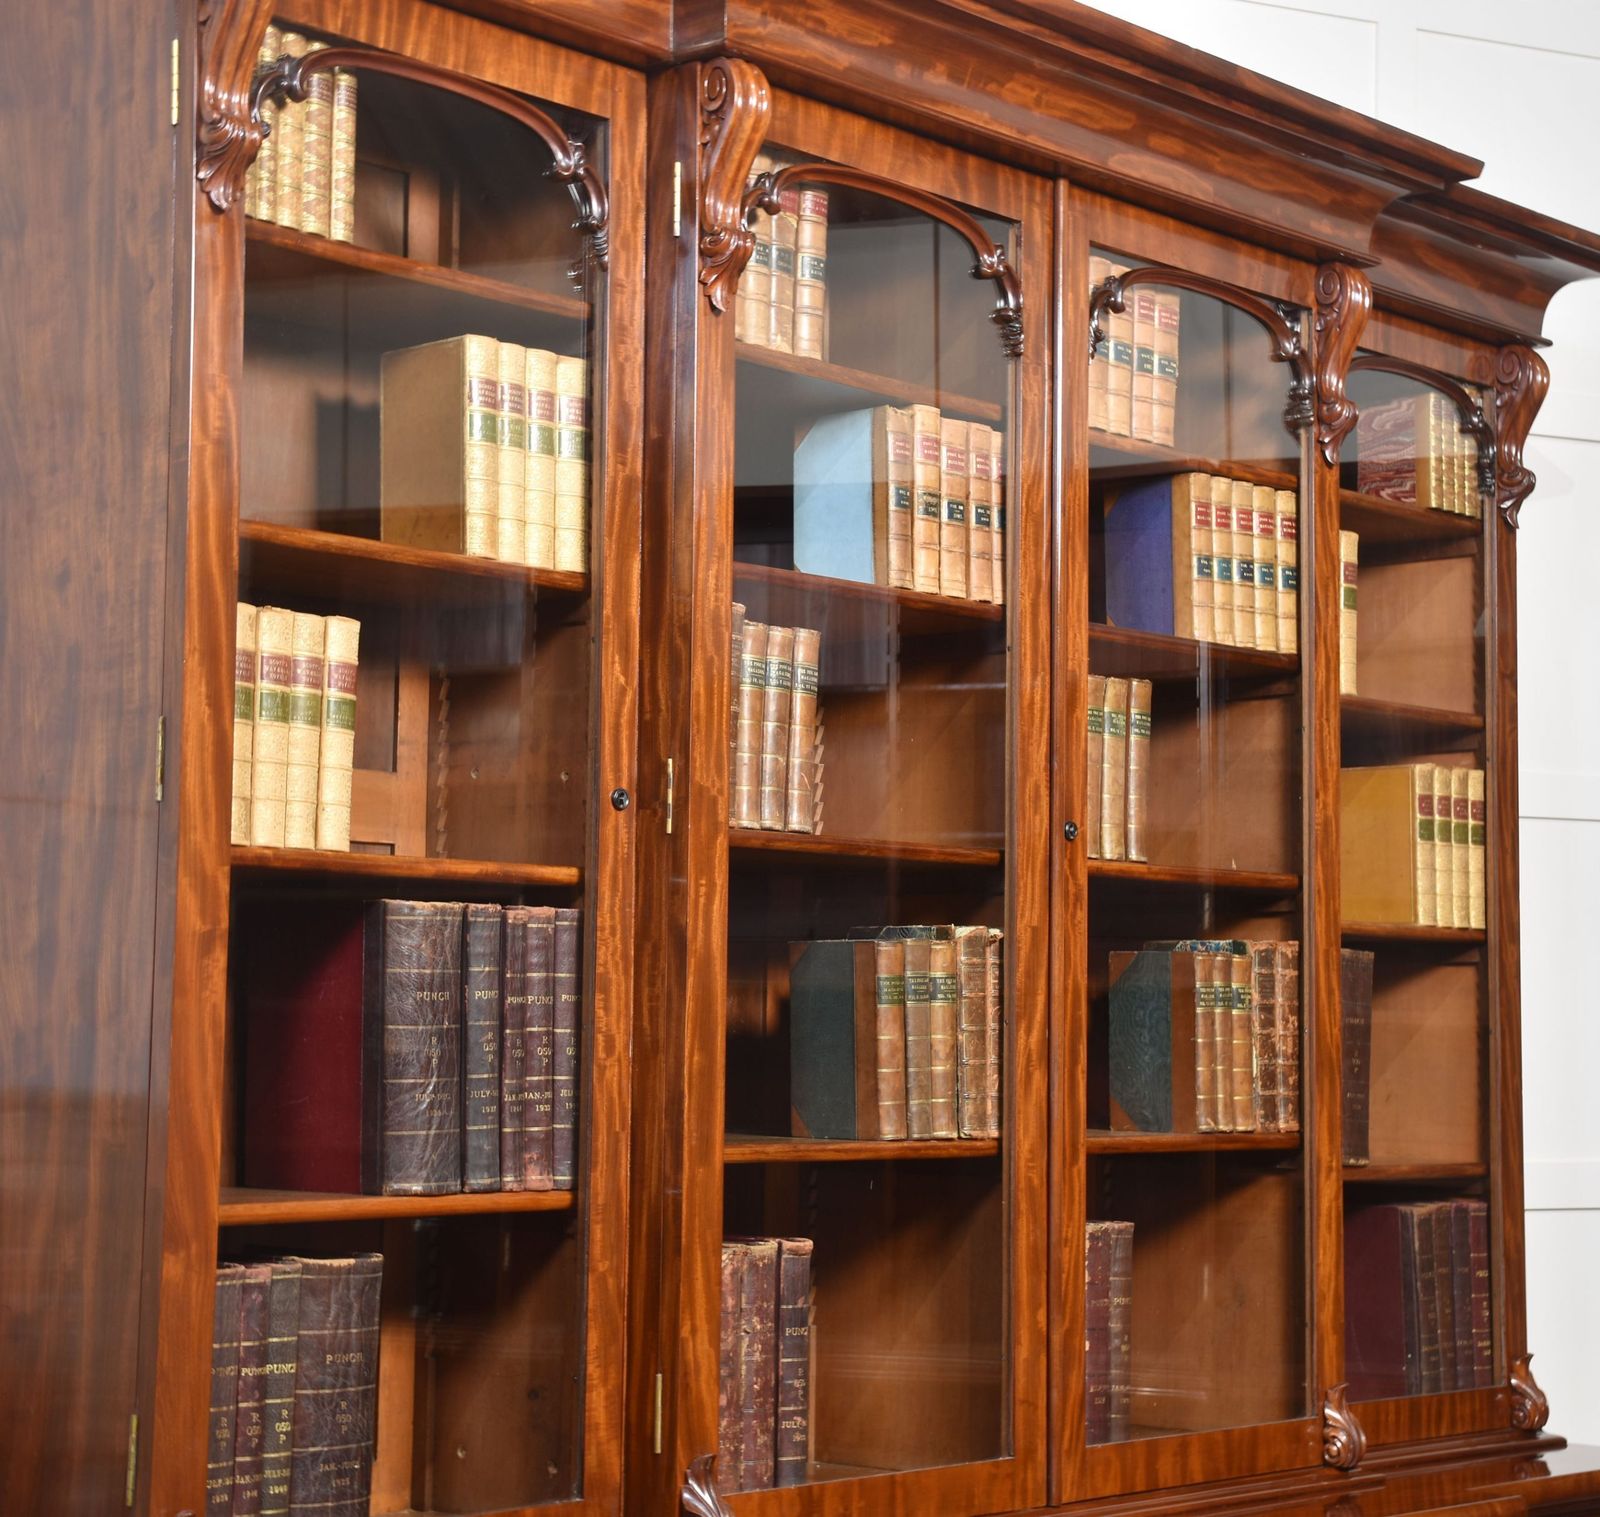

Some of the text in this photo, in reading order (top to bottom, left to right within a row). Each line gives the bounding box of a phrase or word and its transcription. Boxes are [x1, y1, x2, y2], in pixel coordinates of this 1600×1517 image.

[416, 991, 451, 1001] PUNCH
[475, 990, 499, 1000] PUNC
[326, 1352, 363, 1364] PUNCH
[266, 1362, 297, 1375] PUNC
[281, 1408, 289, 1419] R
[279, 1433, 287, 1445] P
